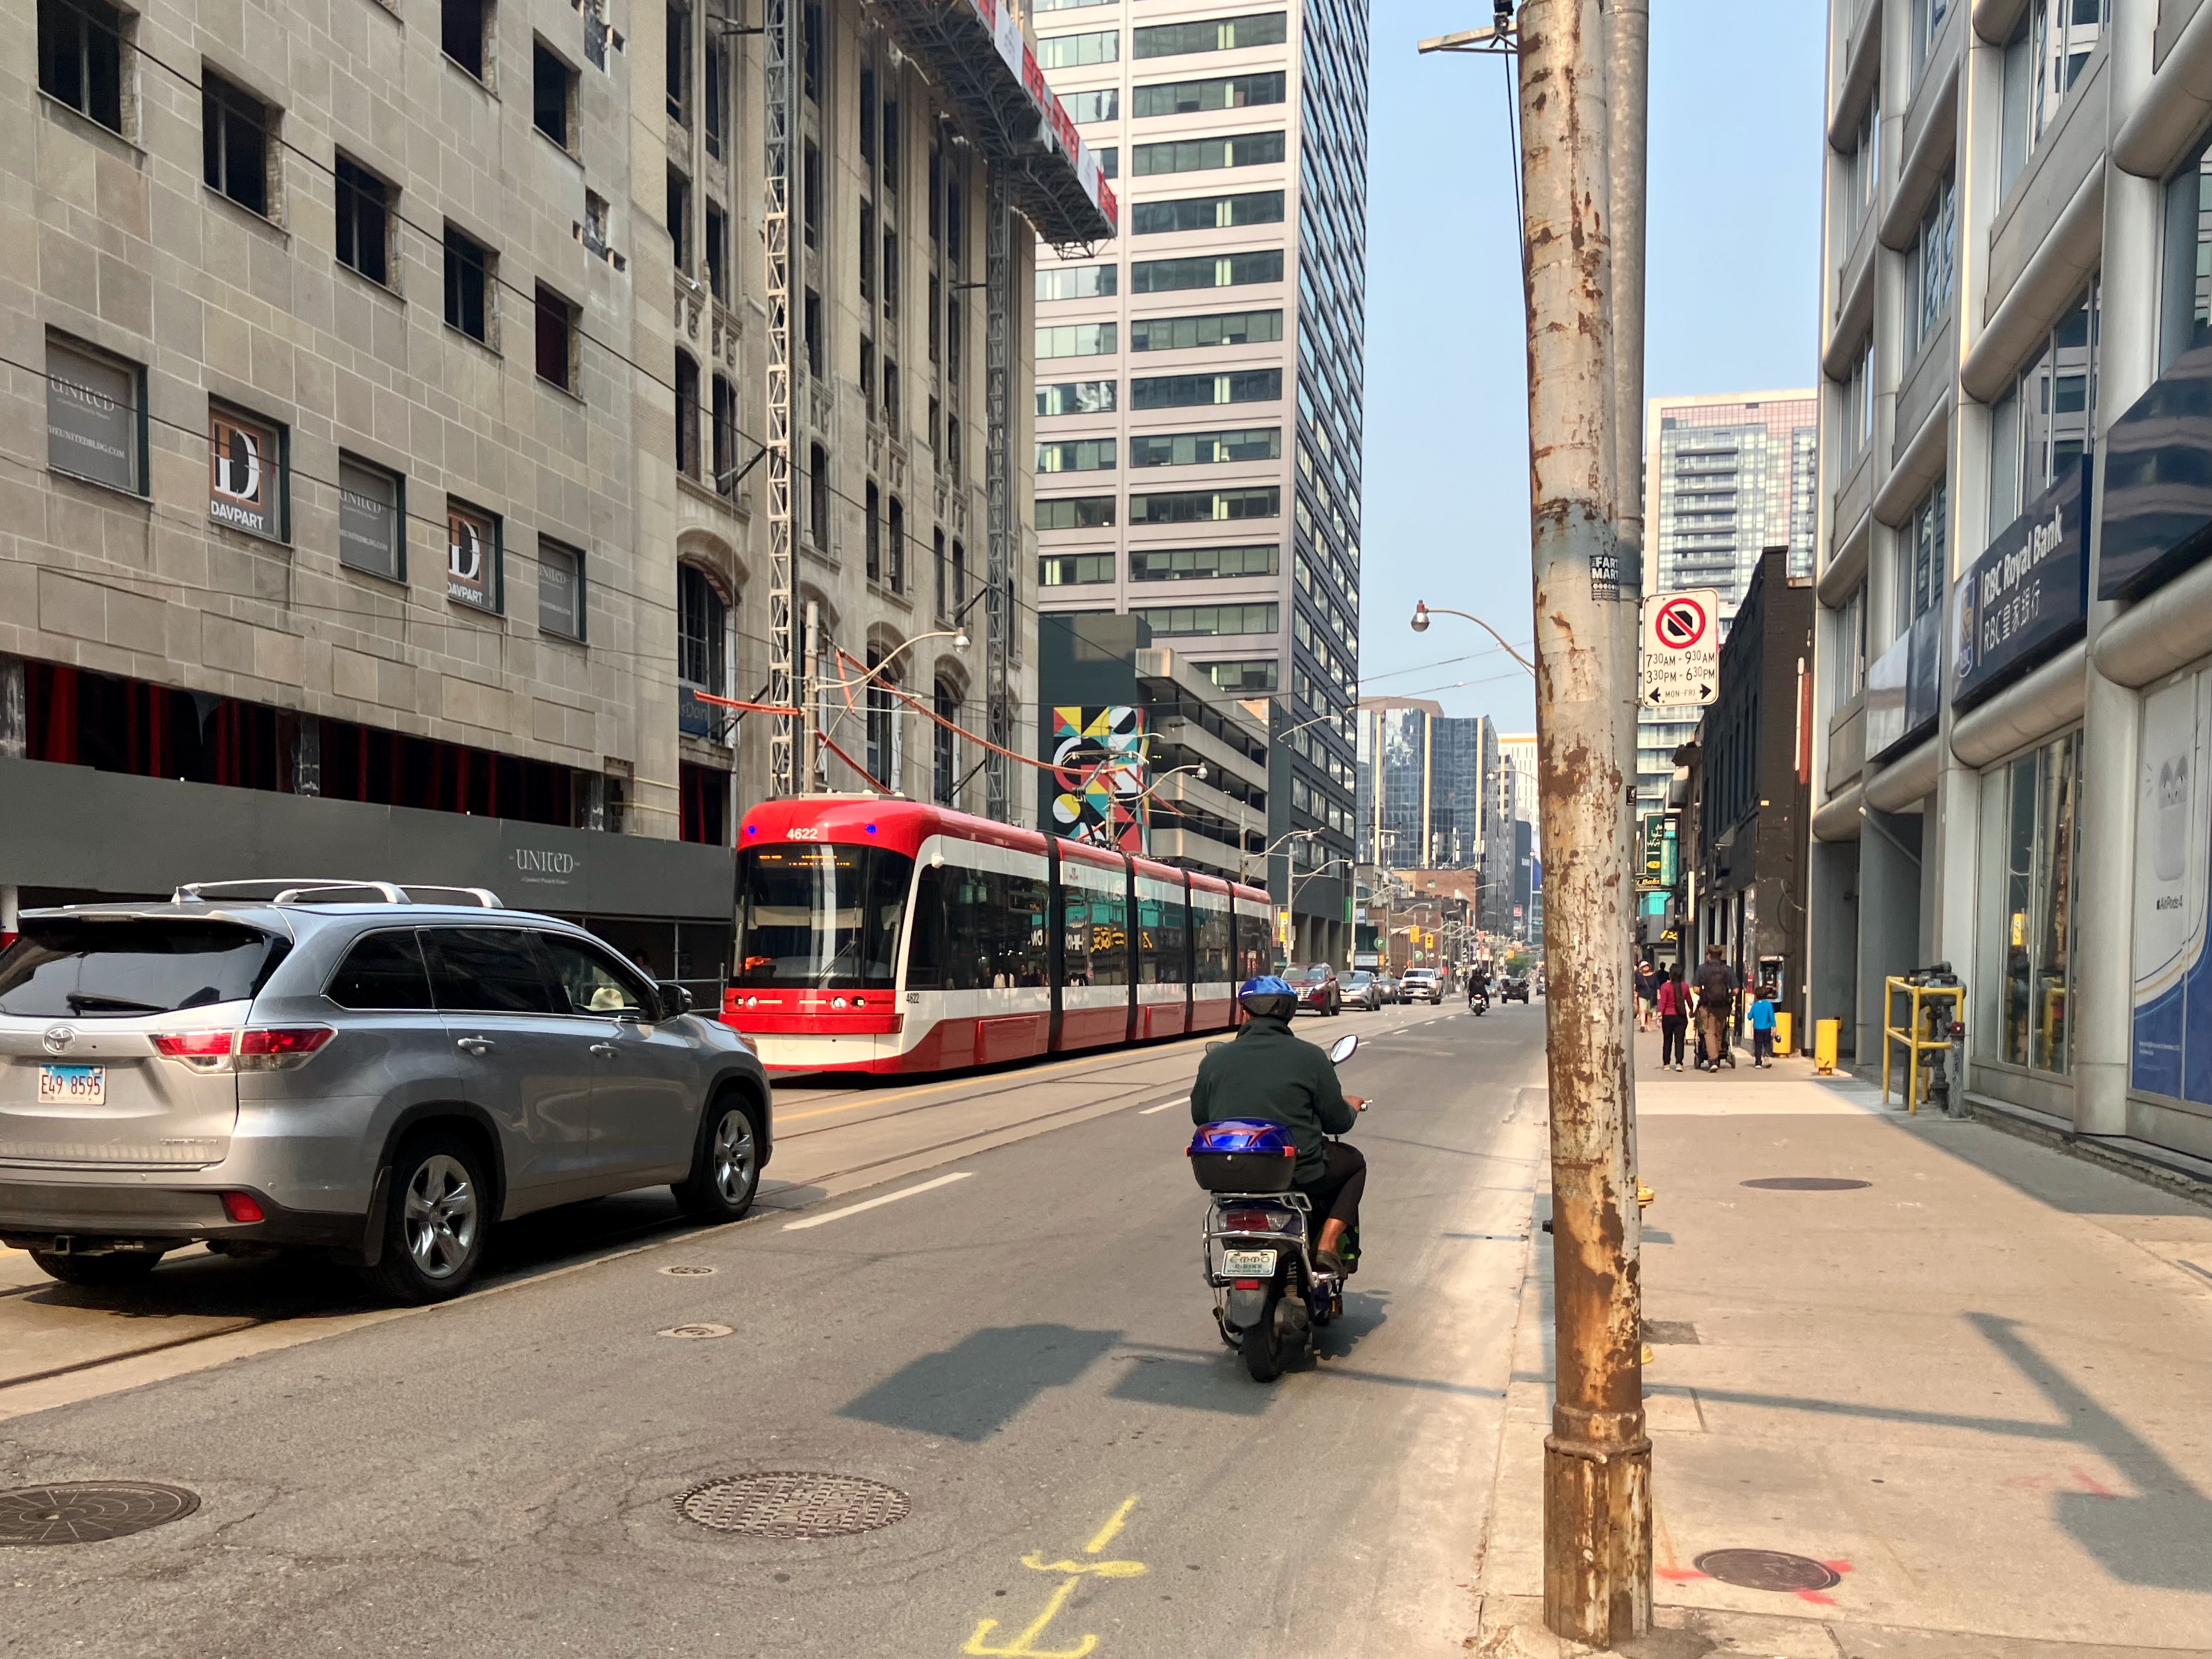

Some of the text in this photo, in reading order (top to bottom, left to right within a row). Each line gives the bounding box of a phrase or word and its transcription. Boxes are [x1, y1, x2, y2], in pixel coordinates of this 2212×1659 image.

[47, 425, 125, 459] HEUNITEDBLDG.COM
[210, 500, 264, 530] DAVPART
[1596, 556, 1618, 569] FART
[1984, 504, 2063, 608] RBC Royal Bank
[1592, 567, 1619, 581] MART
[1984, 610, 2002, 653] RBC
[1665, 689, 1695, 698] MON-FRI
[787, 828, 818, 840] 4622
[906, 993, 919, 1003] 4622
[42, 1074, 100, 1095] E49 8595
